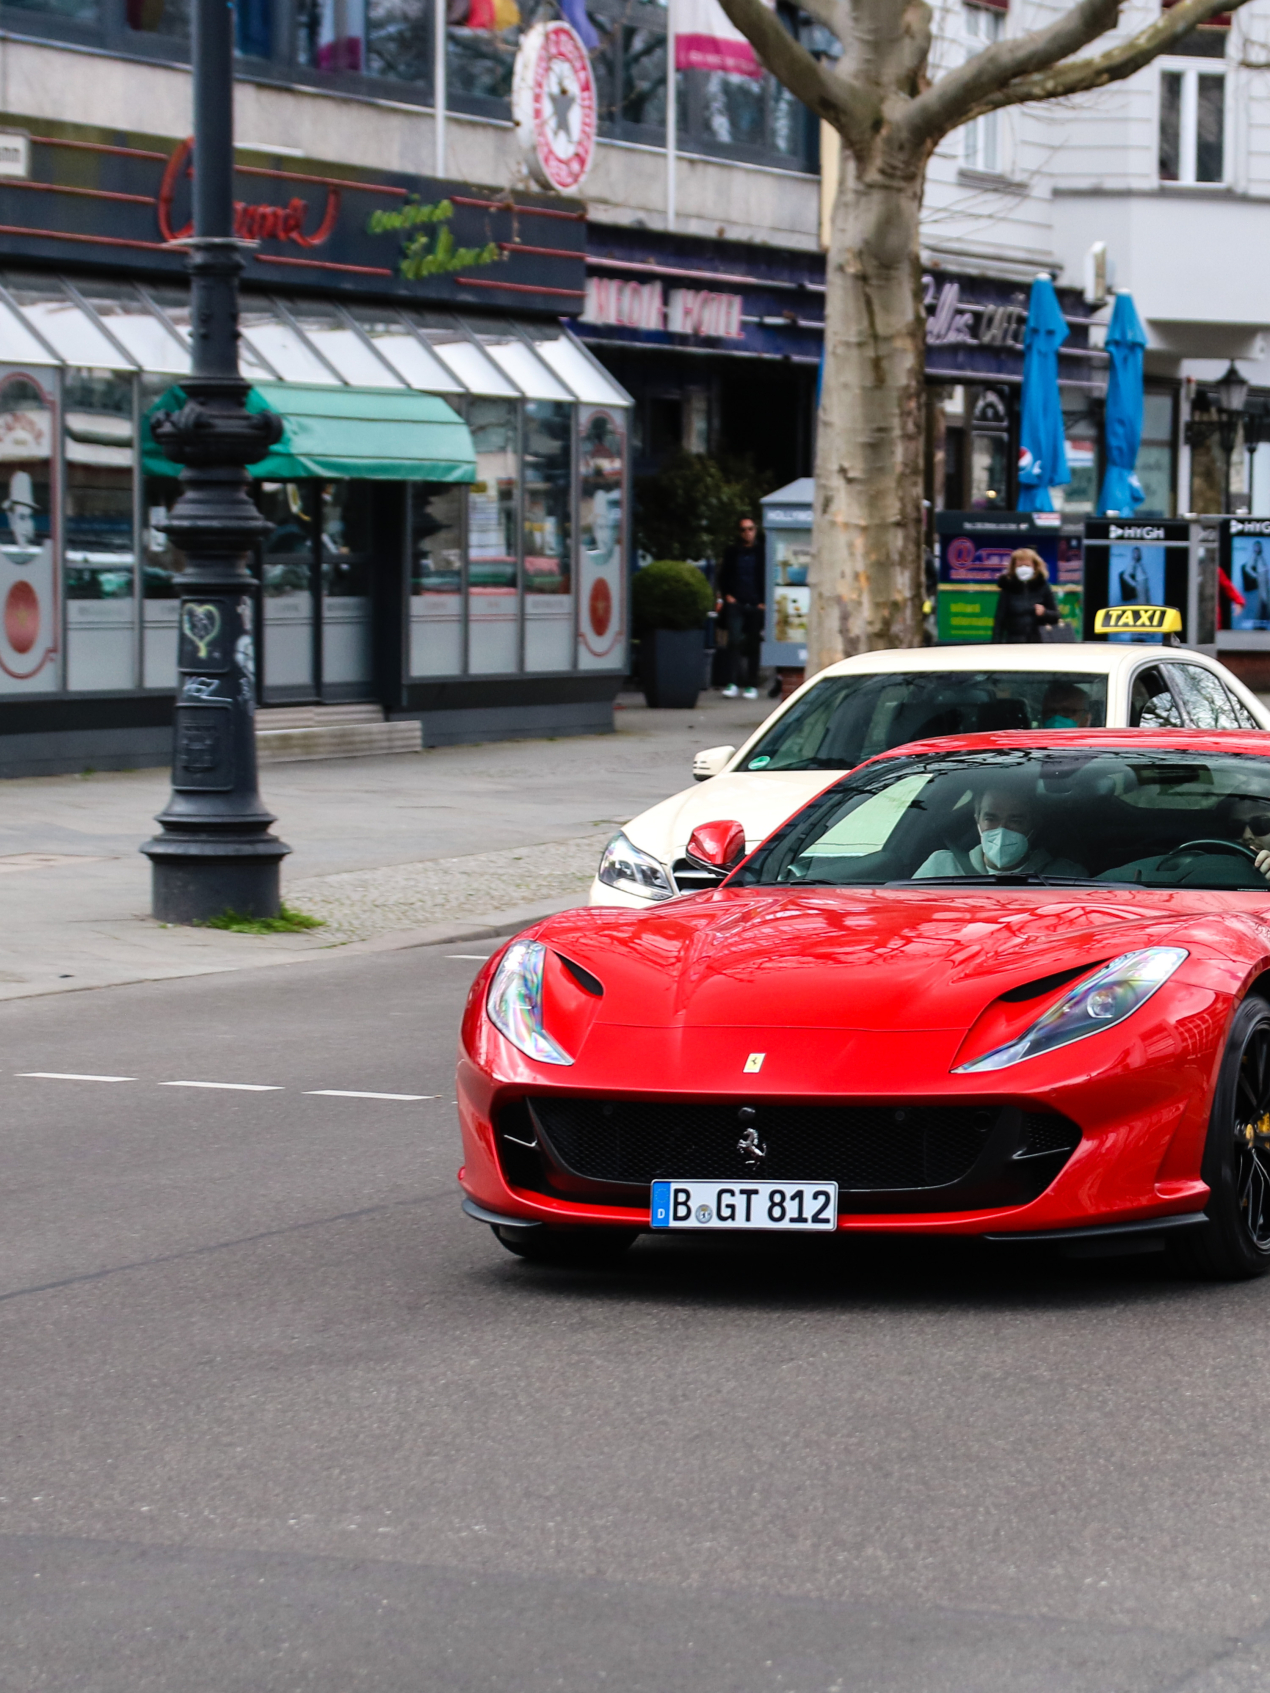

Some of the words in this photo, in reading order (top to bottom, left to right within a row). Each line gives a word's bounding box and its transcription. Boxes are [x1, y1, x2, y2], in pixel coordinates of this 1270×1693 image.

[581, 276, 665, 331] MEDIA
[667, 288, 746, 339] HOTEL
[1123, 526, 1166, 539] HYGH
[1108, 609, 1162, 626] TAXI
[672, 1188, 692, 1222] B
[716, 1188, 760, 1222] GT
[767, 1189, 831, 1224] 812
